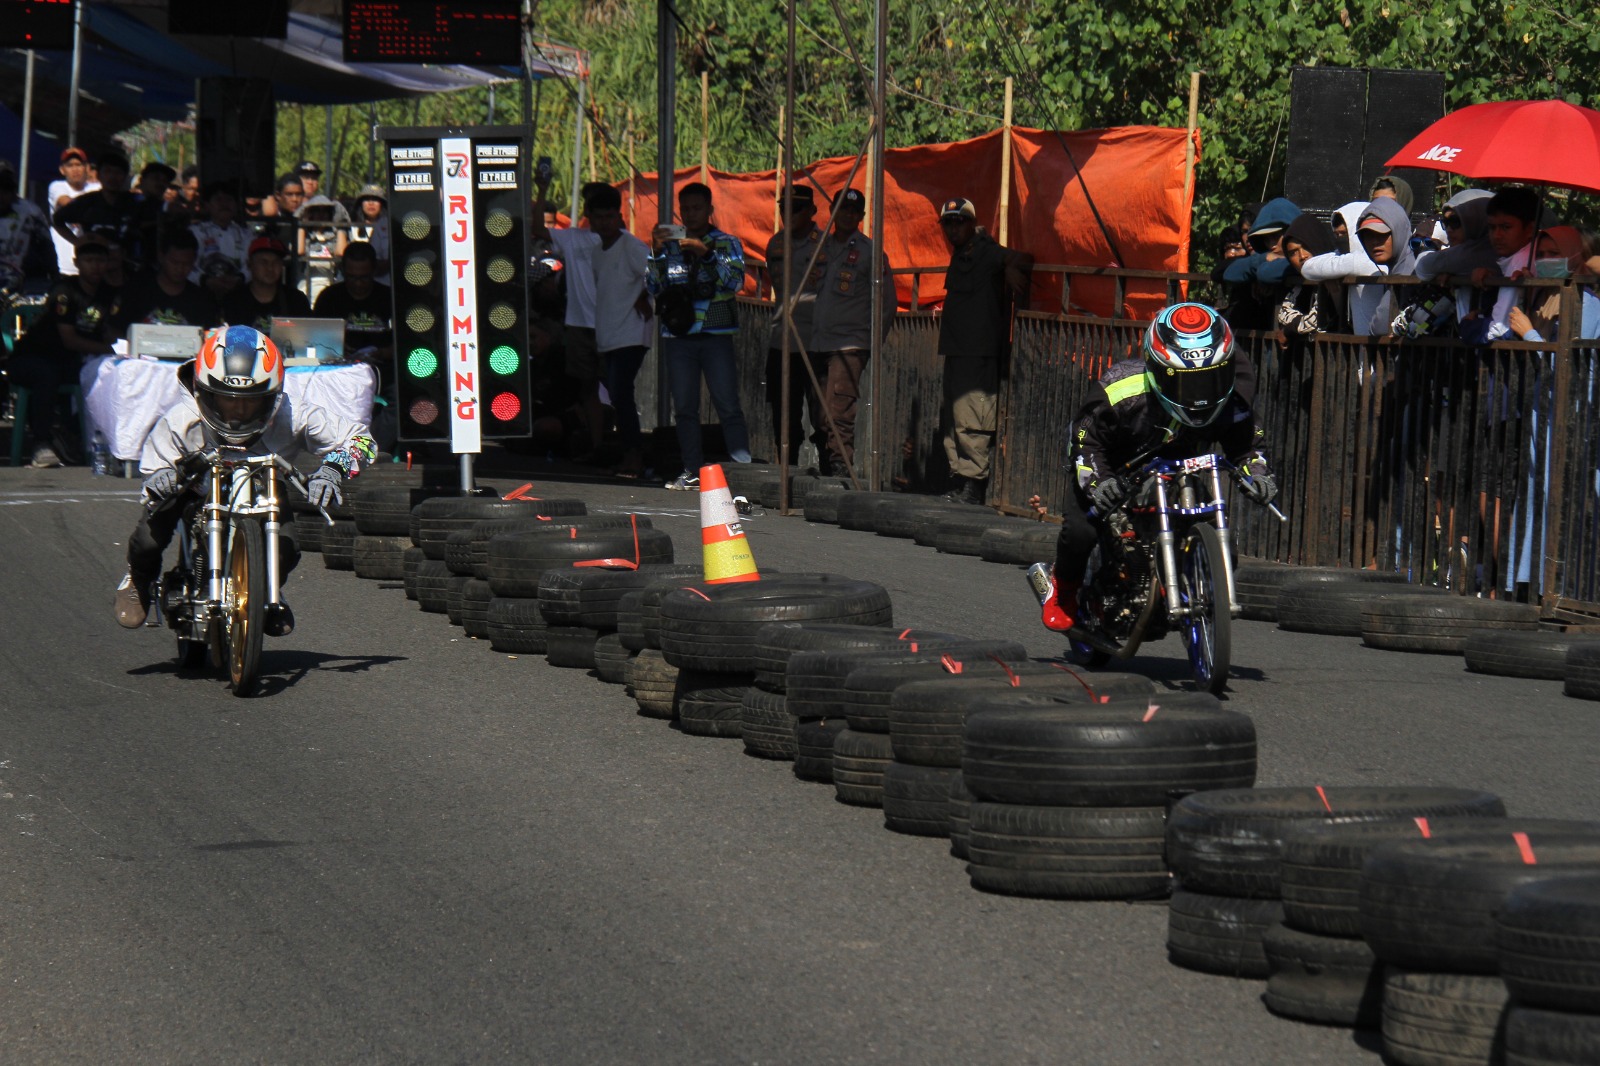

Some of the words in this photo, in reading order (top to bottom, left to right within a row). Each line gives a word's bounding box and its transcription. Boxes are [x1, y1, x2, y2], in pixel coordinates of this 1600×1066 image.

[1417, 143, 1462, 163] ACE
[448, 195, 469, 243] RJ
[451, 259, 475, 420] TIMING
[1183, 349, 1212, 360] KYT
[225, 376, 254, 386] KYT
